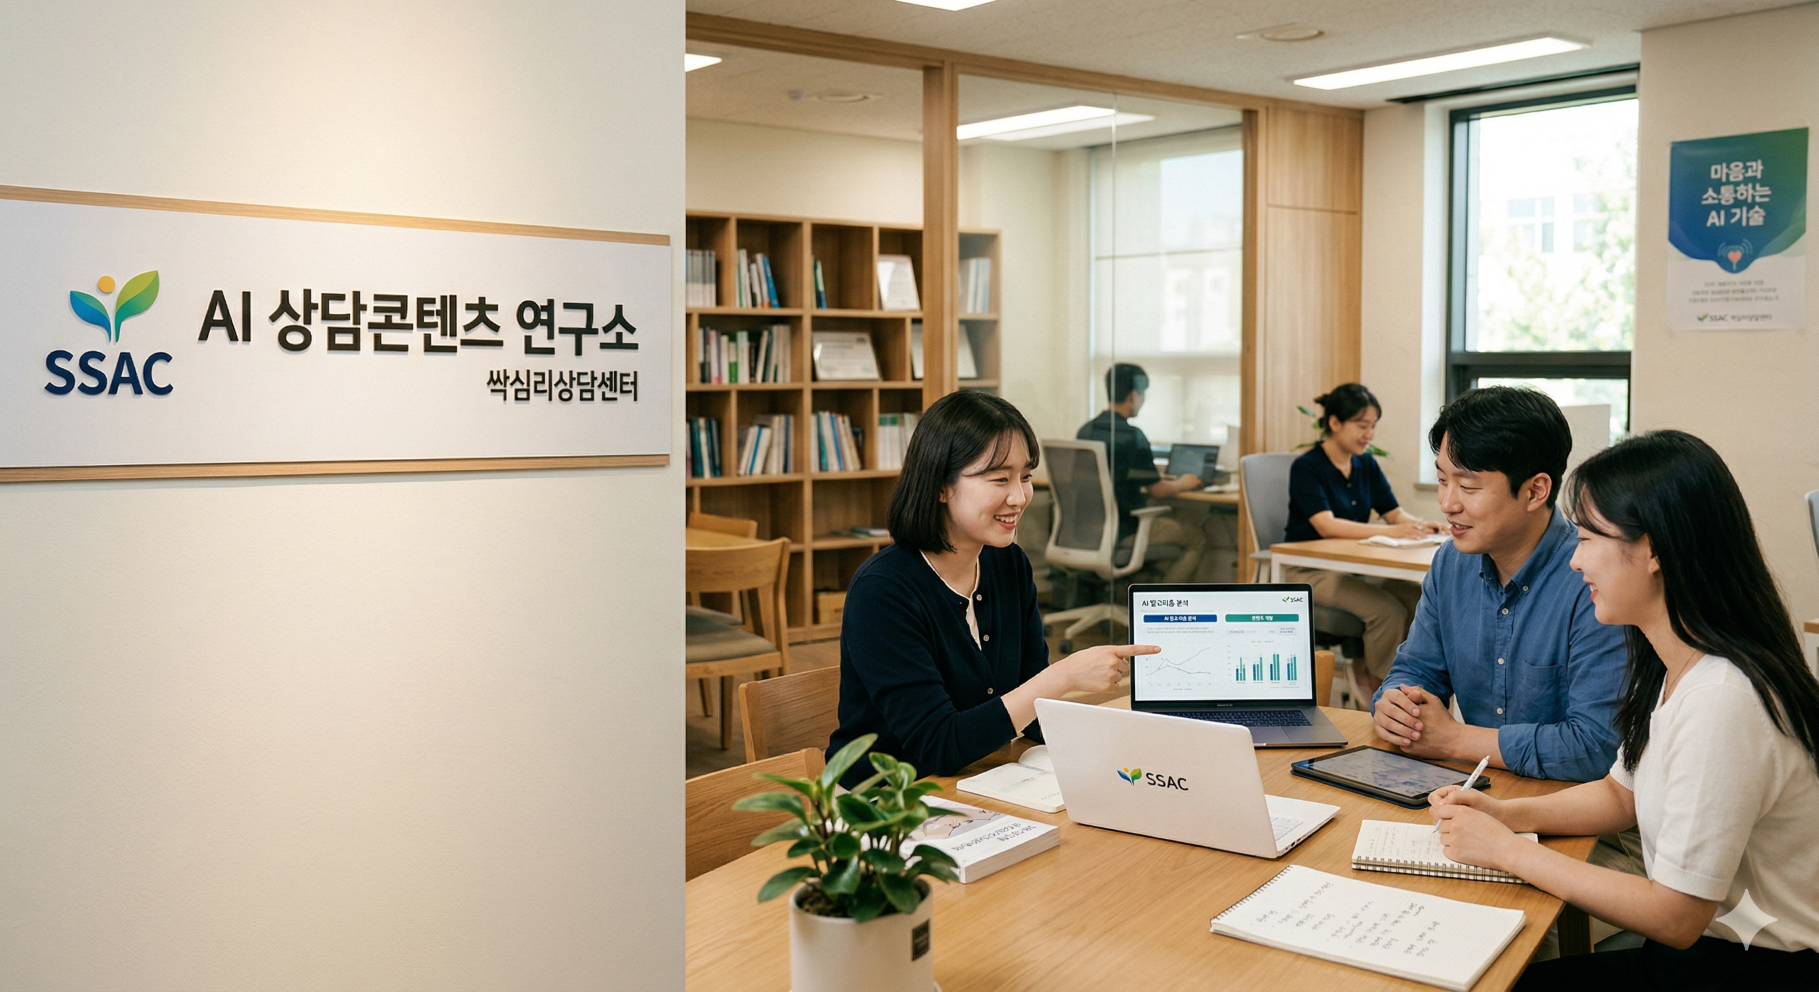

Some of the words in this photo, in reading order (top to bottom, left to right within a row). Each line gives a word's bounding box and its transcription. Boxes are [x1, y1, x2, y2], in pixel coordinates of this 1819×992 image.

[1710, 159, 1764, 182] 마음과
[1701, 183, 1772, 206] 소통하는
[1706, 210, 1725, 227] AI
[1730, 205, 1766, 226] 기술
[198, 289, 252, 343] AI
[268, 288, 505, 354] 상담콘텐츠
[515, 298, 639, 356] 연구소
[44, 350, 174, 396] SSAC
[486, 368, 639, 402] 싹심리상담센터
[1145, 772, 1189, 791] SSAC
